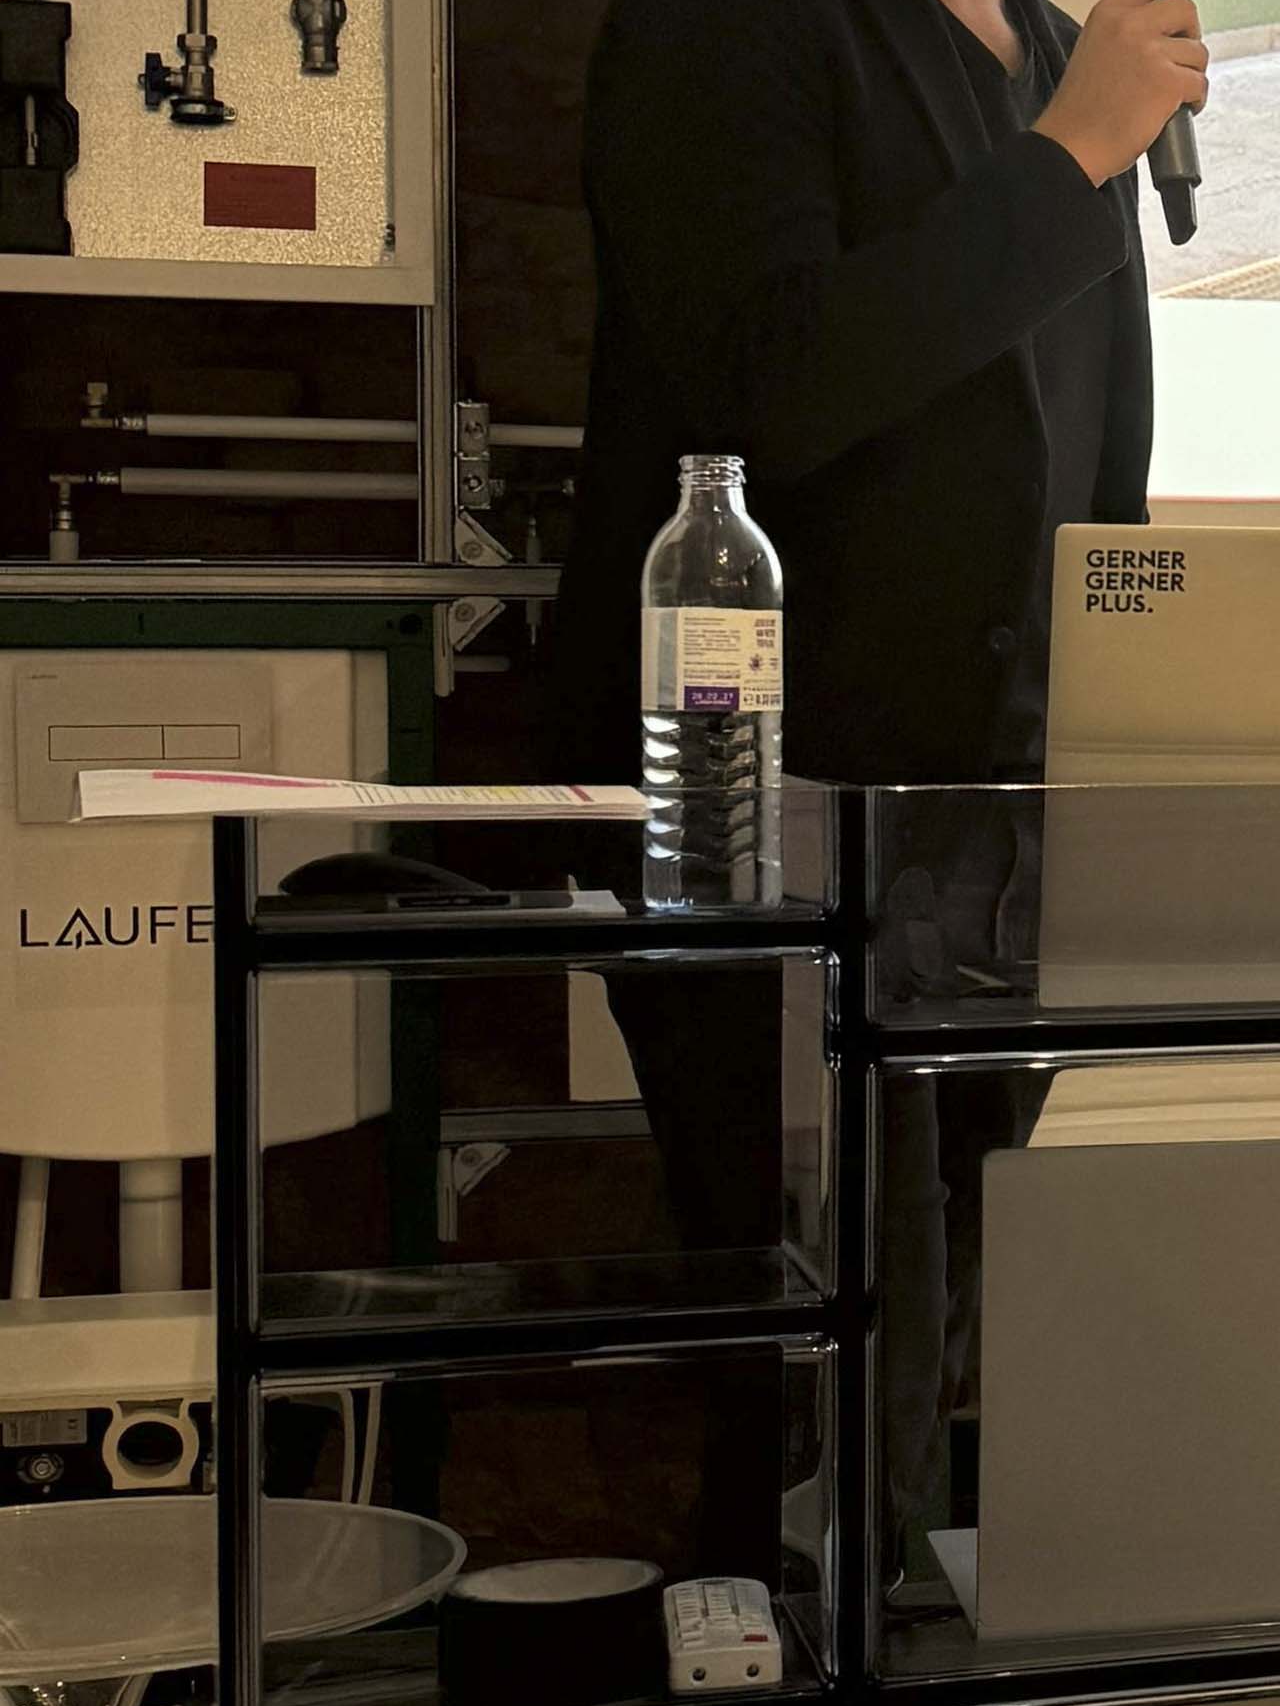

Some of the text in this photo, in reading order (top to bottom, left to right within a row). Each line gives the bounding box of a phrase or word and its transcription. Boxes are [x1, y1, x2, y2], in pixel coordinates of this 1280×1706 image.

[1086, 549, 1186, 570] GERNER
[1085, 571, 1185, 592] GERNER
[1086, 594, 1154, 613] PLUS.
[20, 904, 214, 949] LAUFE
